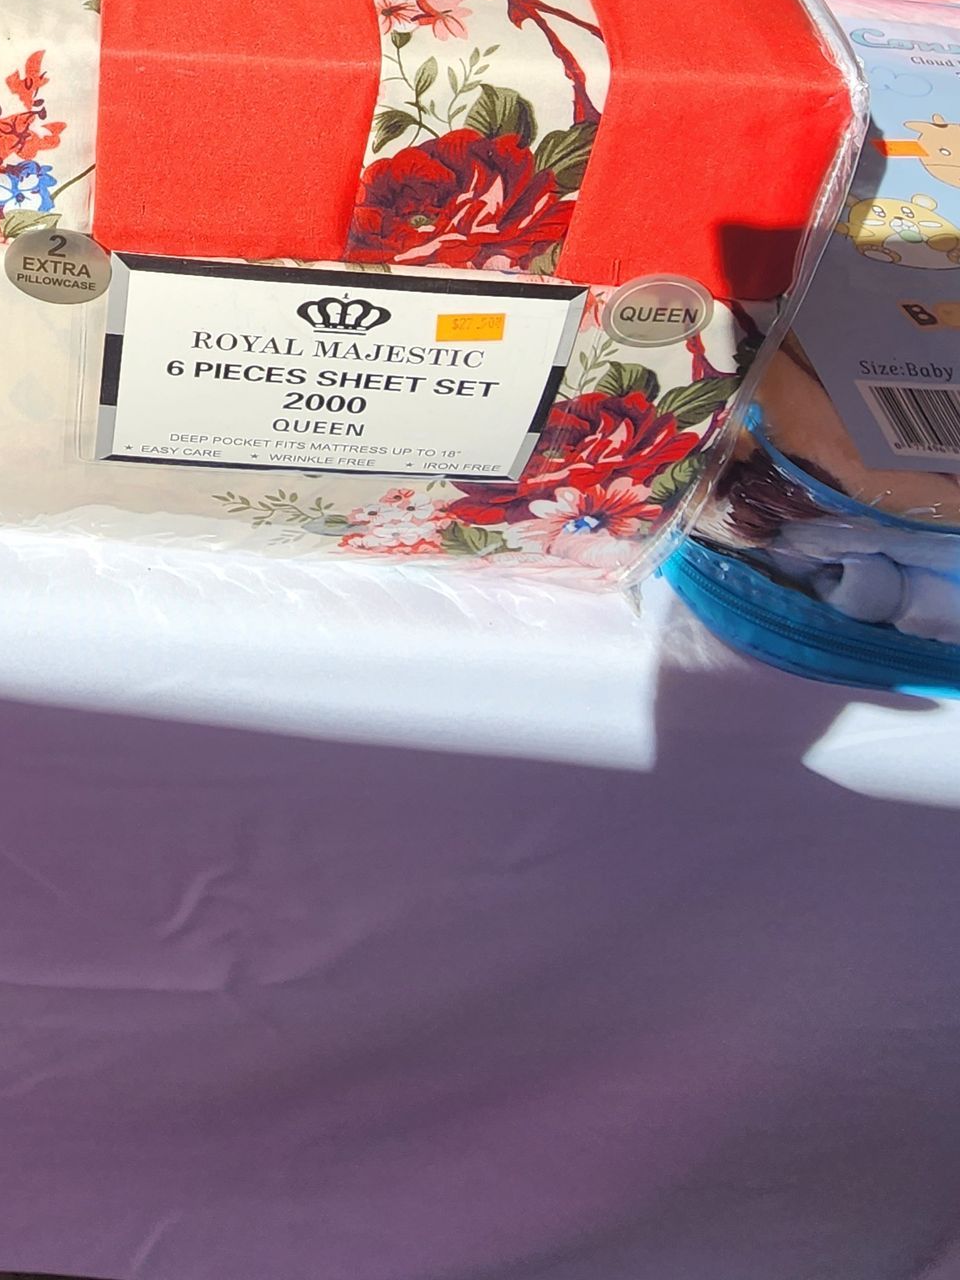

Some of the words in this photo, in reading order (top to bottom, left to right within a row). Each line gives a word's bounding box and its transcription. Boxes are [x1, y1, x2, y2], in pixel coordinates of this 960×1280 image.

[910, 56, 956, 67] Cloud
[47, 234, 68, 258] 2
[22, 256, 91, 279] EXTRA
[16, 273, 97, 291] PILLOWCASE
[619, 306, 699, 324] QUEEN
[190, 330, 304, 357] ROYAL
[312, 340, 485, 368] MAJESTIC
[166, 360, 185, 377] 6
[193, 362, 307, 385] PIECES
[316, 370, 428, 393] SHEET
[433, 379, 500, 398] SET
[859, 360, 953, 381] Size:Baby
[282, 392, 368, 414] 2000
[272, 419, 365, 437] QUEEN
[170, 433, 208, 444] DEEP
[212, 437, 271, 449] POCKET
[275, 439, 307, 450] FITS
[310, 441, 388, 456] MATTRESS
[392, 446, 412, 457] UP
[417, 448, 436, 457] TO
[140, 444, 180, 456] EASY
[183, 447, 222, 458] CARE
[269, 453, 334, 466] WRINKLE
[337, 456, 377, 467] FREE
[422, 461, 460, 471] IRON
[464, 463, 502, 472] FREE
